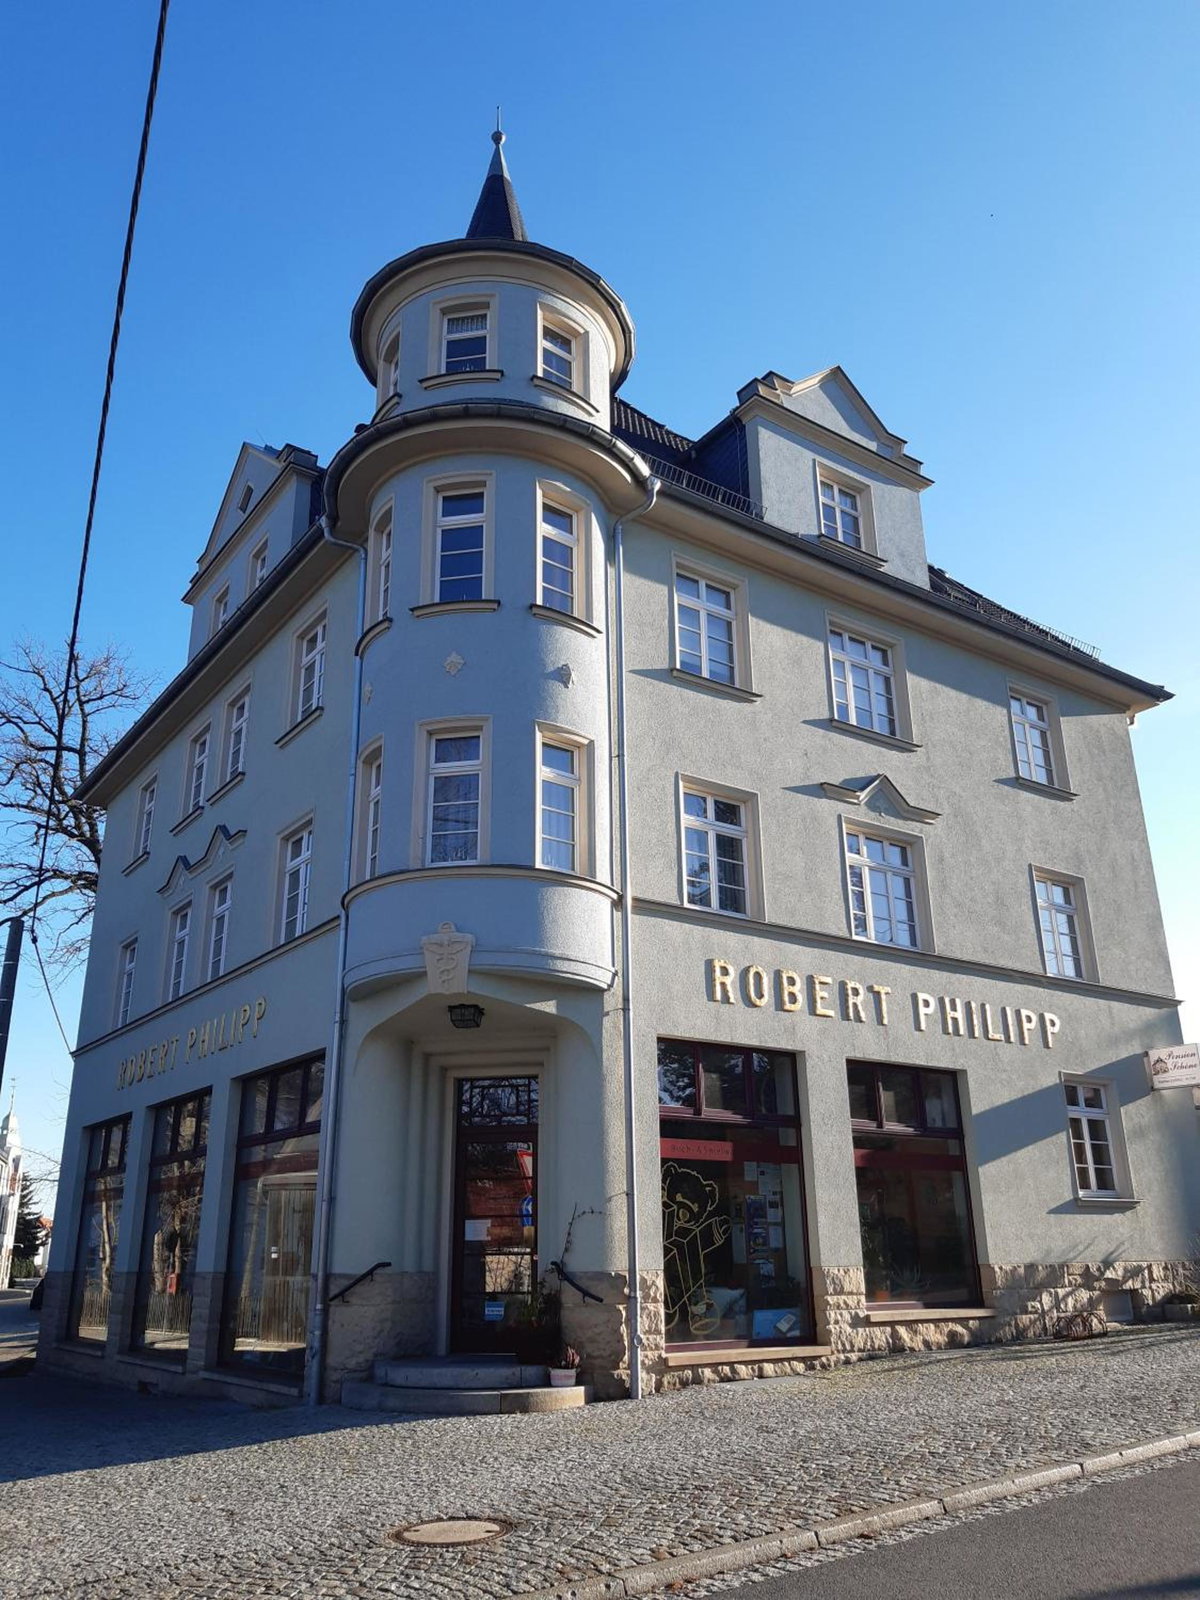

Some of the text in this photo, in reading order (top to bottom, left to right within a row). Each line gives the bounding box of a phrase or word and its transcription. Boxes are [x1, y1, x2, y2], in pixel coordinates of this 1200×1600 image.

[116, 996, 267, 1091] ROBERT PHILIPP
[711, 958, 1061, 1049] ROBERT PHILIPP
